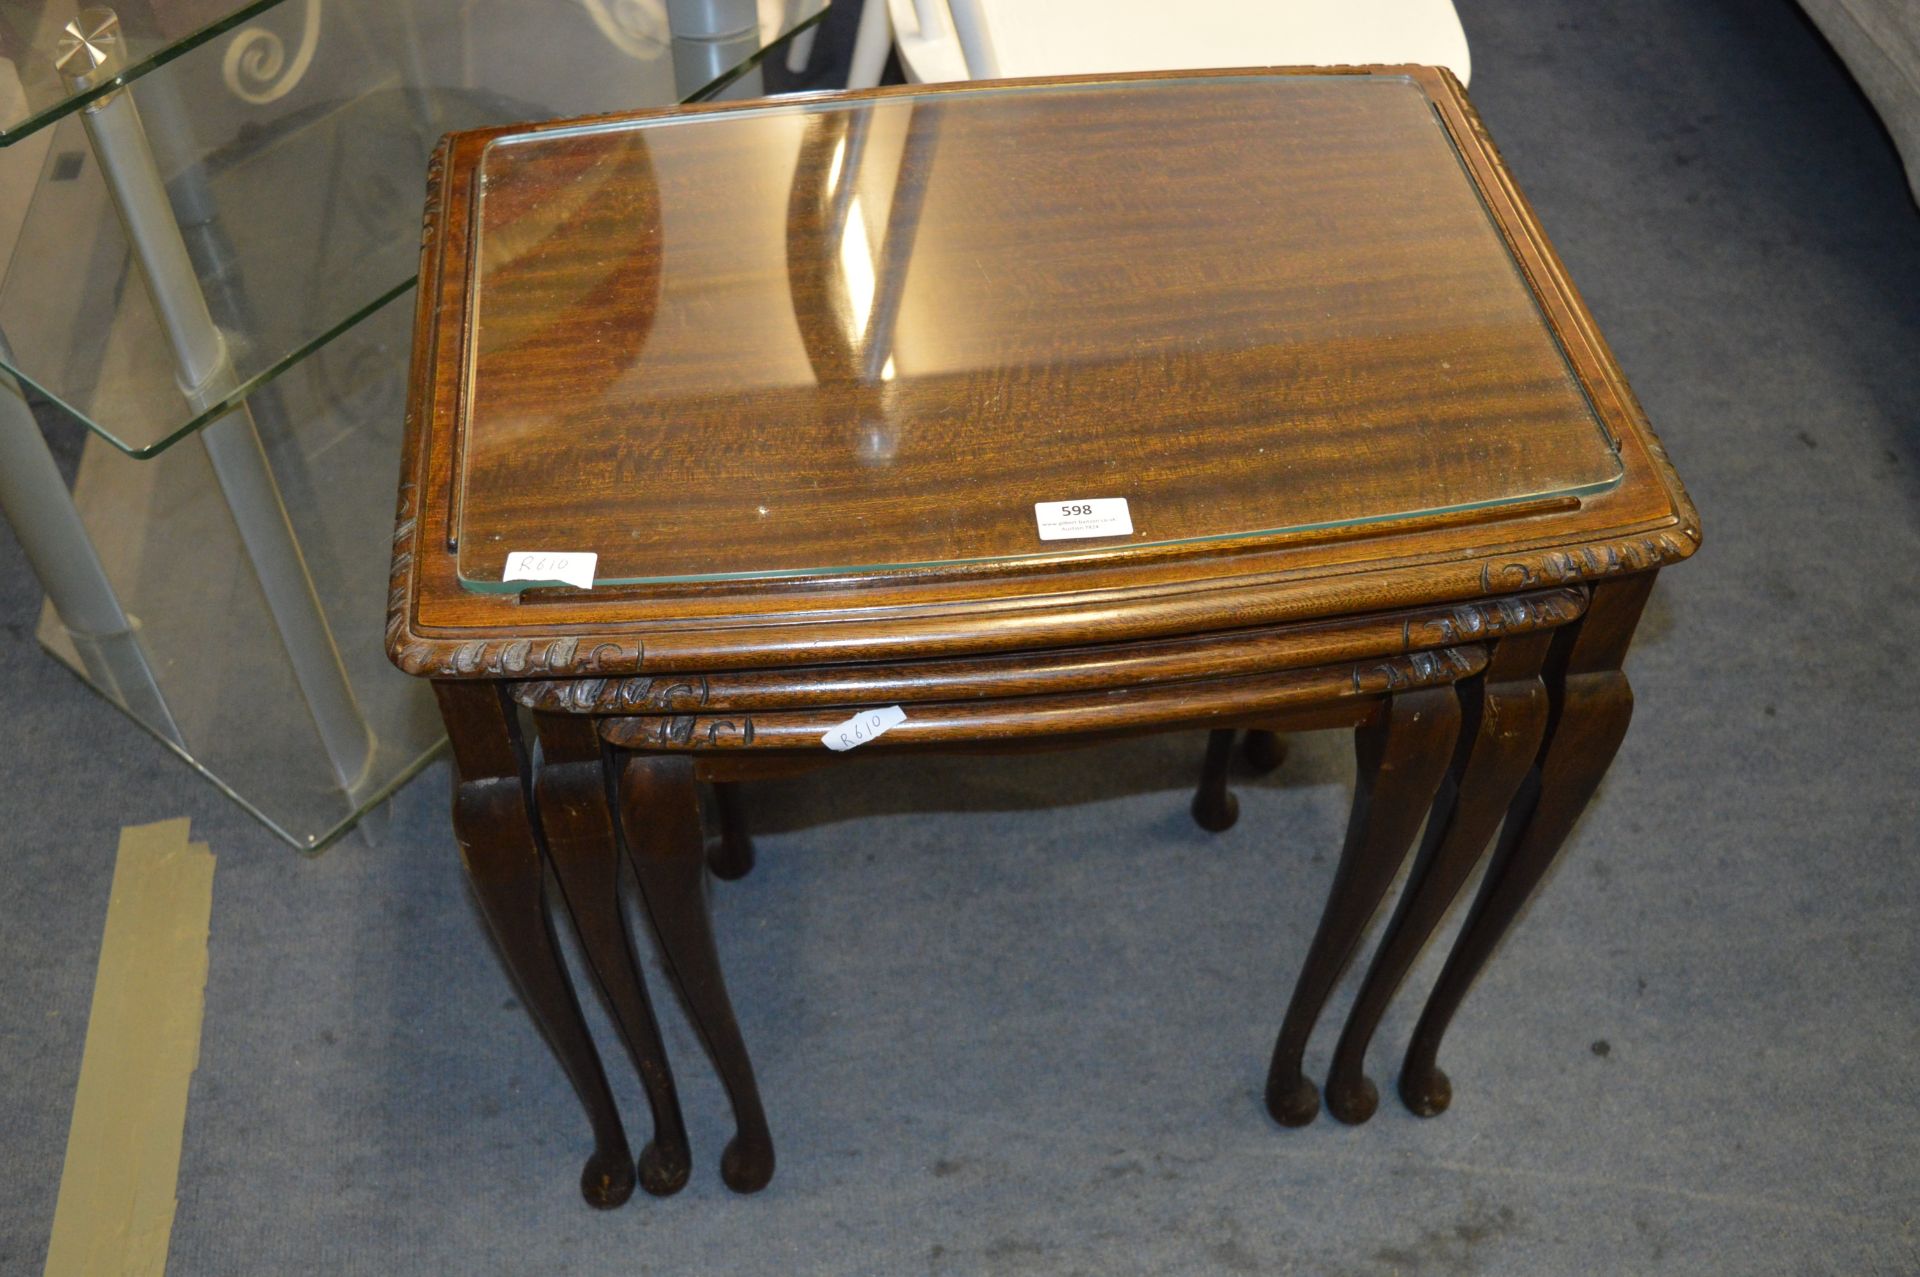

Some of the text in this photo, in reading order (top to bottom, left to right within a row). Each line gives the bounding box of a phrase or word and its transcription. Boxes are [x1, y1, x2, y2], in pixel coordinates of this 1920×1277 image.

[1061, 504, 1093, 517] 598
[518, 555, 569, 572] R610
[840, 715, 881, 747] R610
